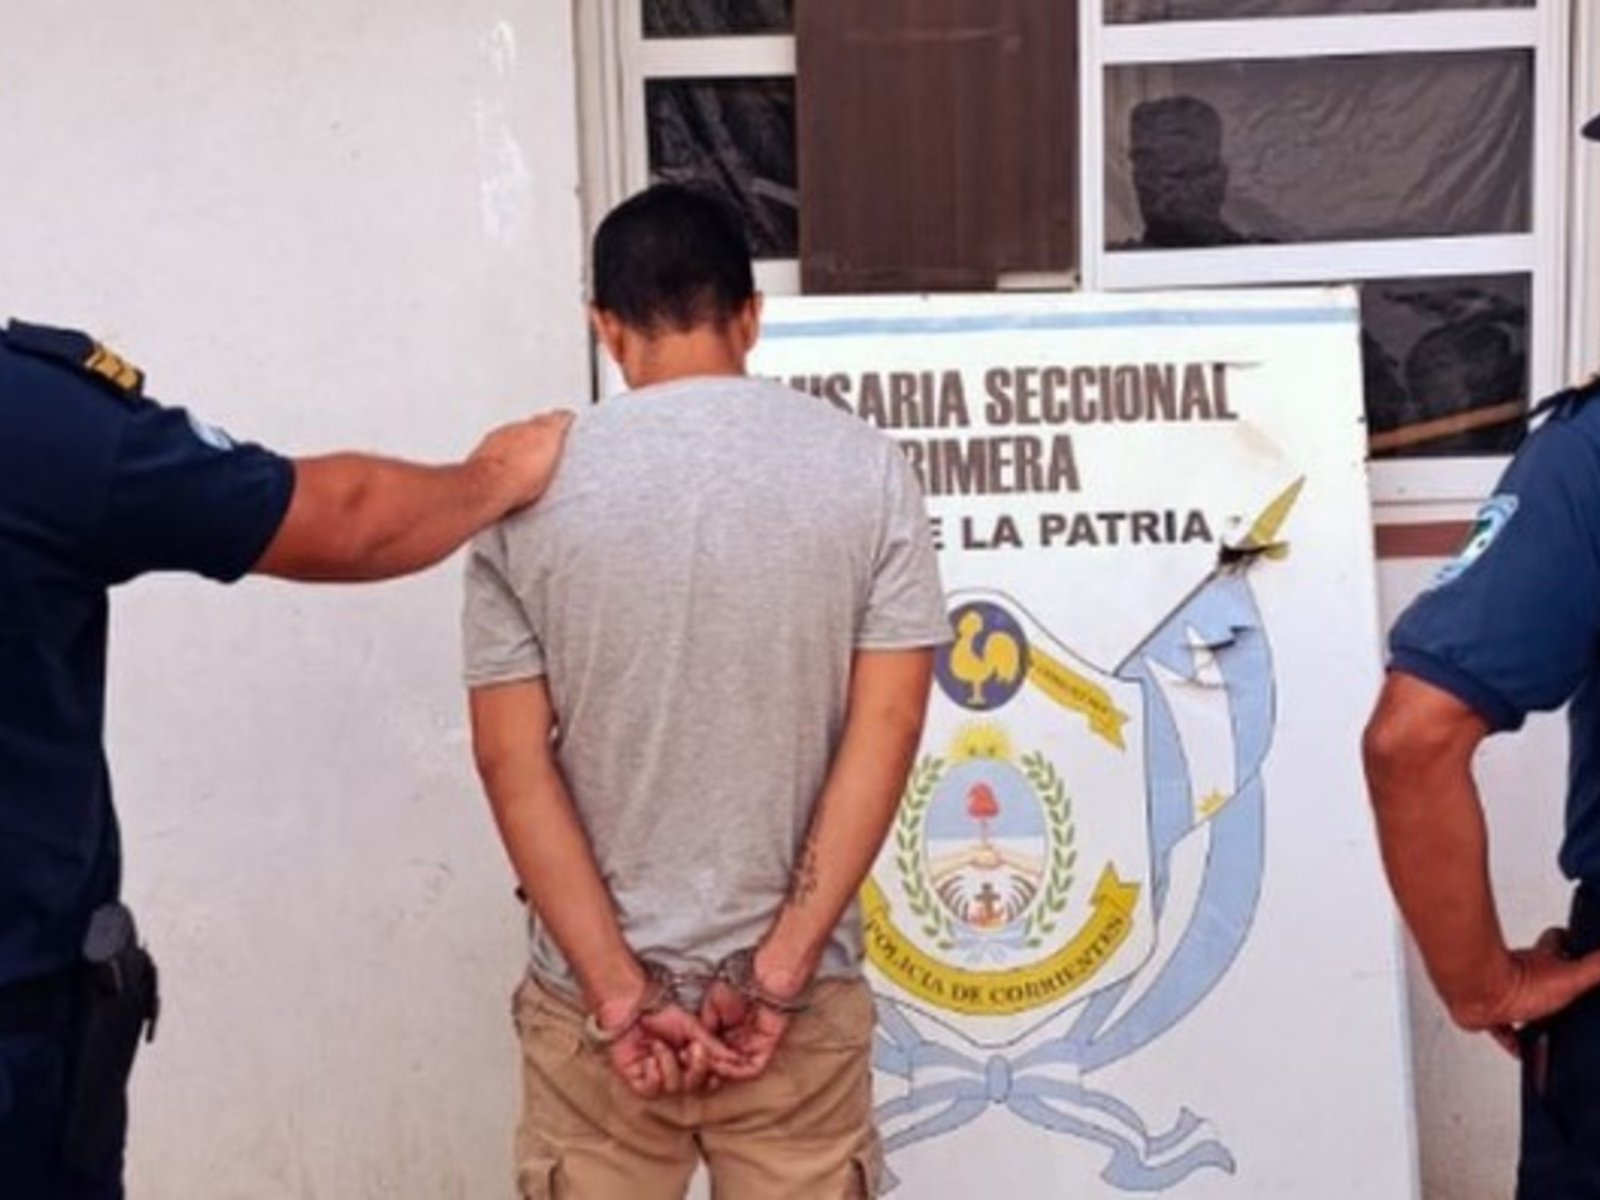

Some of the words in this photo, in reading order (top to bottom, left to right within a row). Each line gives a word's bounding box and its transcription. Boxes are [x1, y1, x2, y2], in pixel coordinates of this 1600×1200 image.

[774, 370, 969, 430] SARIA
[984, 362, 1239, 425] SECCIONAL
[899, 433, 1081, 496] RIMERA
[962, 515, 1024, 550] LA
[1039, 509, 1214, 547] PATRIA
[864, 918, 944, 995] POLICIA
[951, 983, 982, 1004] DE
[988, 917, 1123, 1005] CORRIENTES
